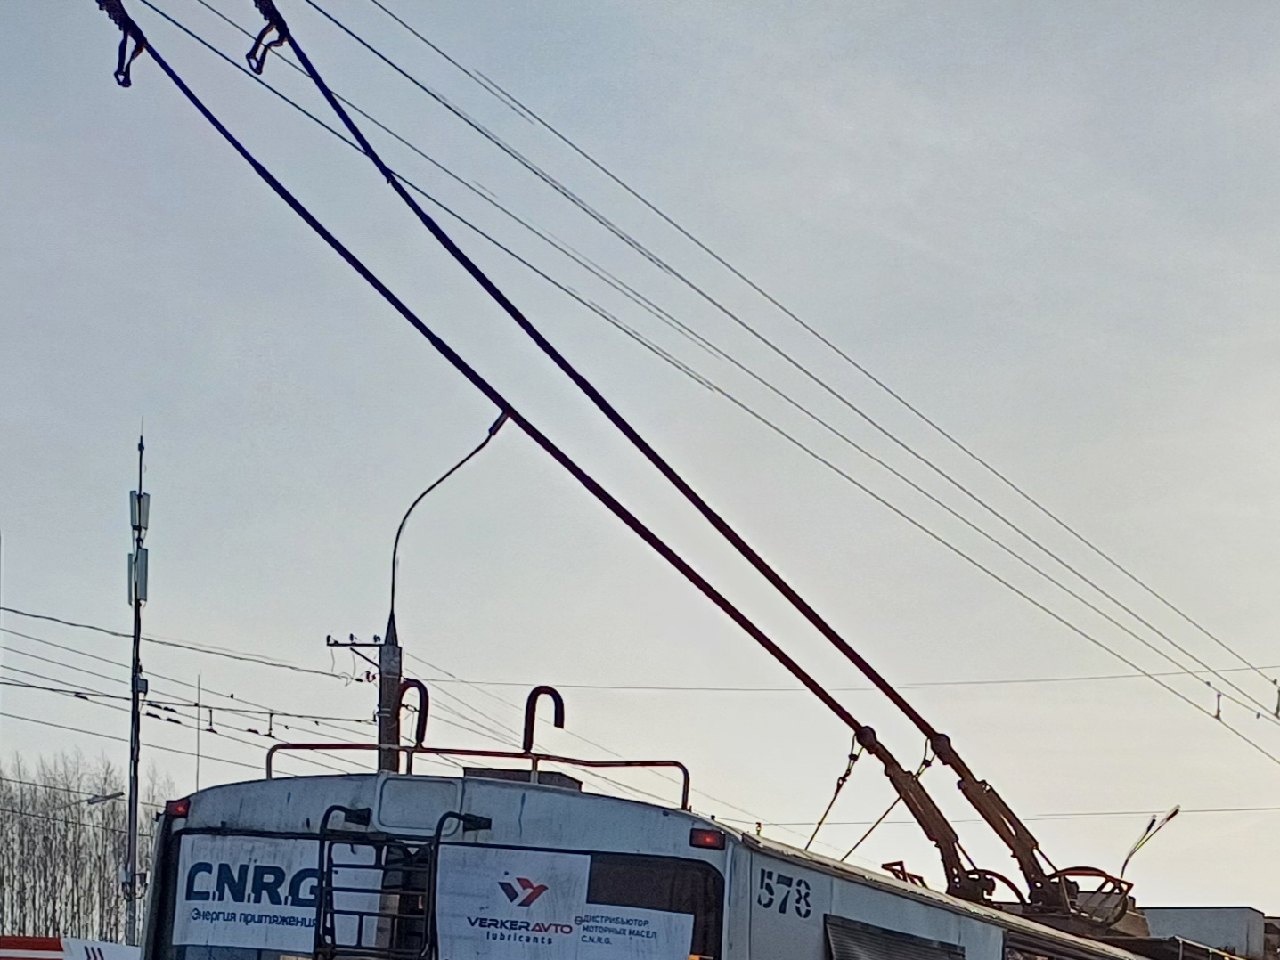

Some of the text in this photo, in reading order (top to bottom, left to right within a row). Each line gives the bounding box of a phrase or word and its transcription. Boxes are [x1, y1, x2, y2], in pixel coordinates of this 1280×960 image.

[757, 868, 811, 918] 578
[191, 907, 236, 923] Энергия
[629, 929, 657, 939] МАСЕЛ
